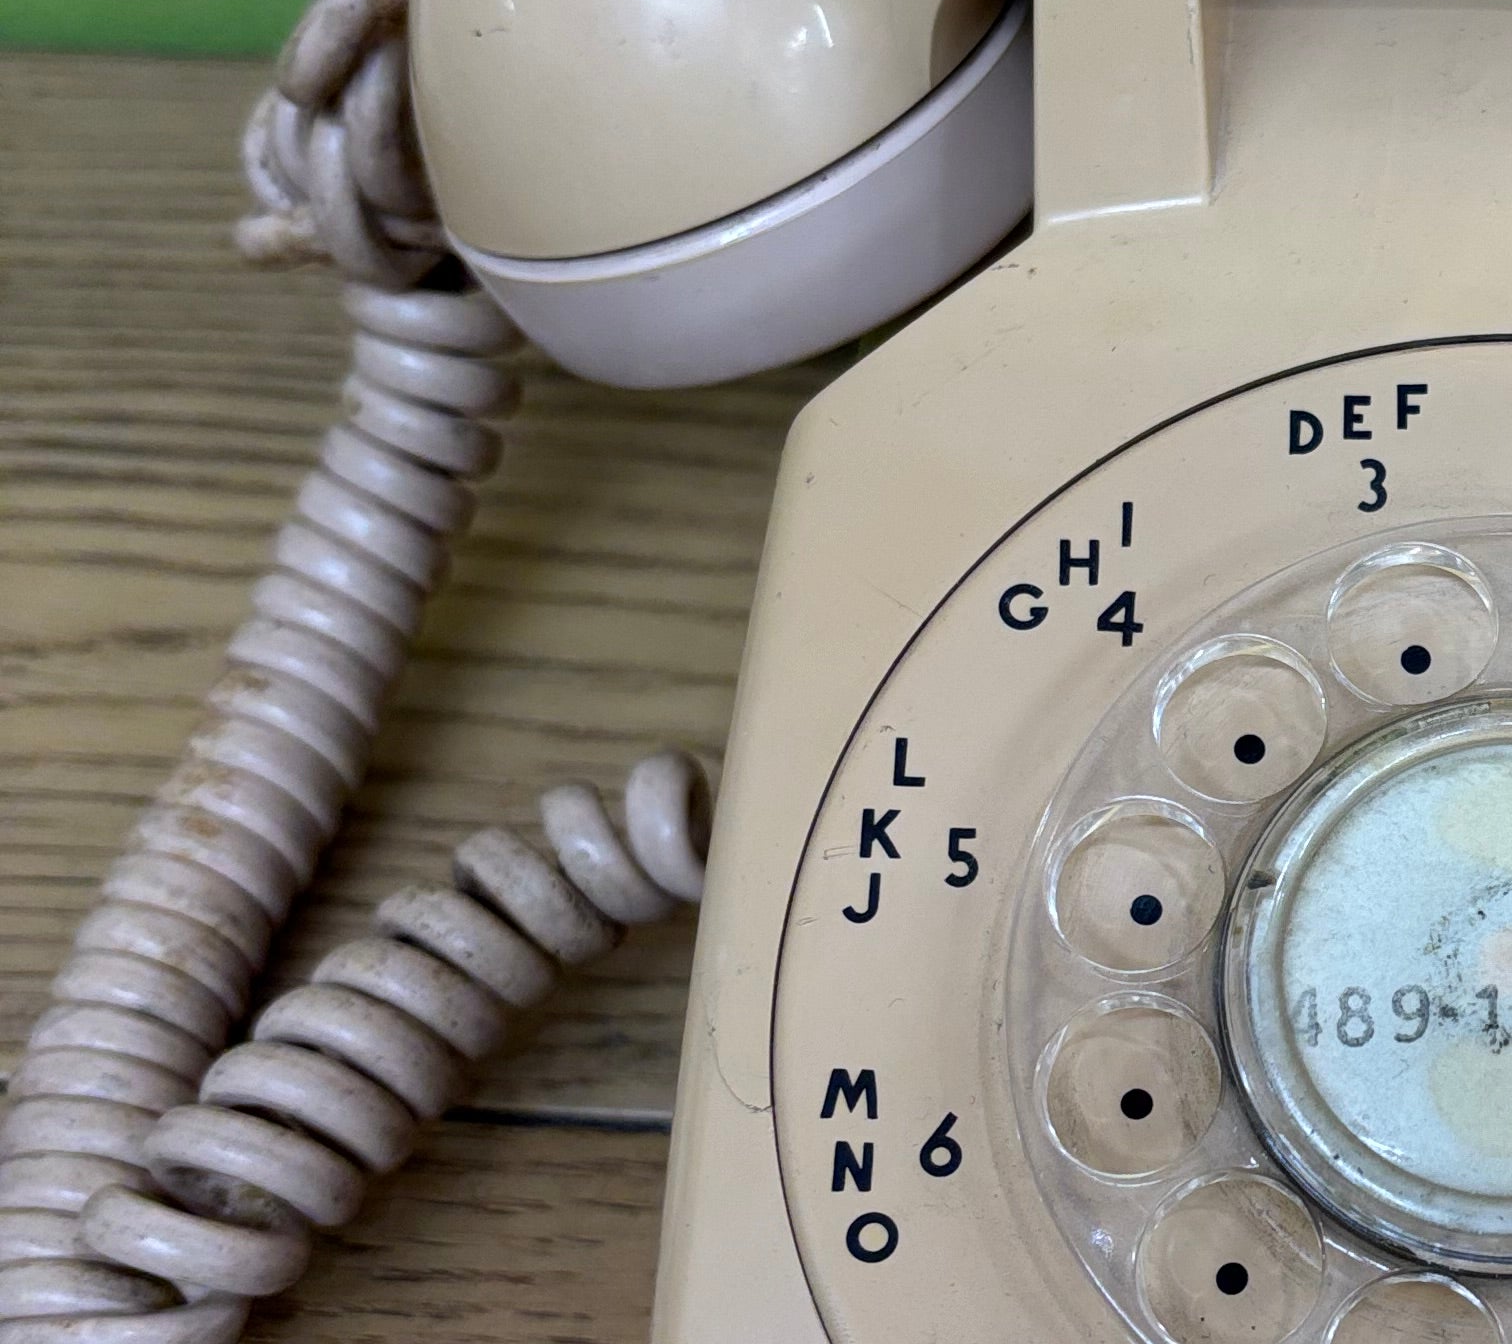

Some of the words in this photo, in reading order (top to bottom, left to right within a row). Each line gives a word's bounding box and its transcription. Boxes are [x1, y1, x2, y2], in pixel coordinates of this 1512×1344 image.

[1287, 382, 1429, 456] DEF
[1356, 457, 1389, 514] 3
[1095, 589, 1145, 648] 4
[943, 826, 980, 889] 5
[918, 1110, 964, 1179] 6
